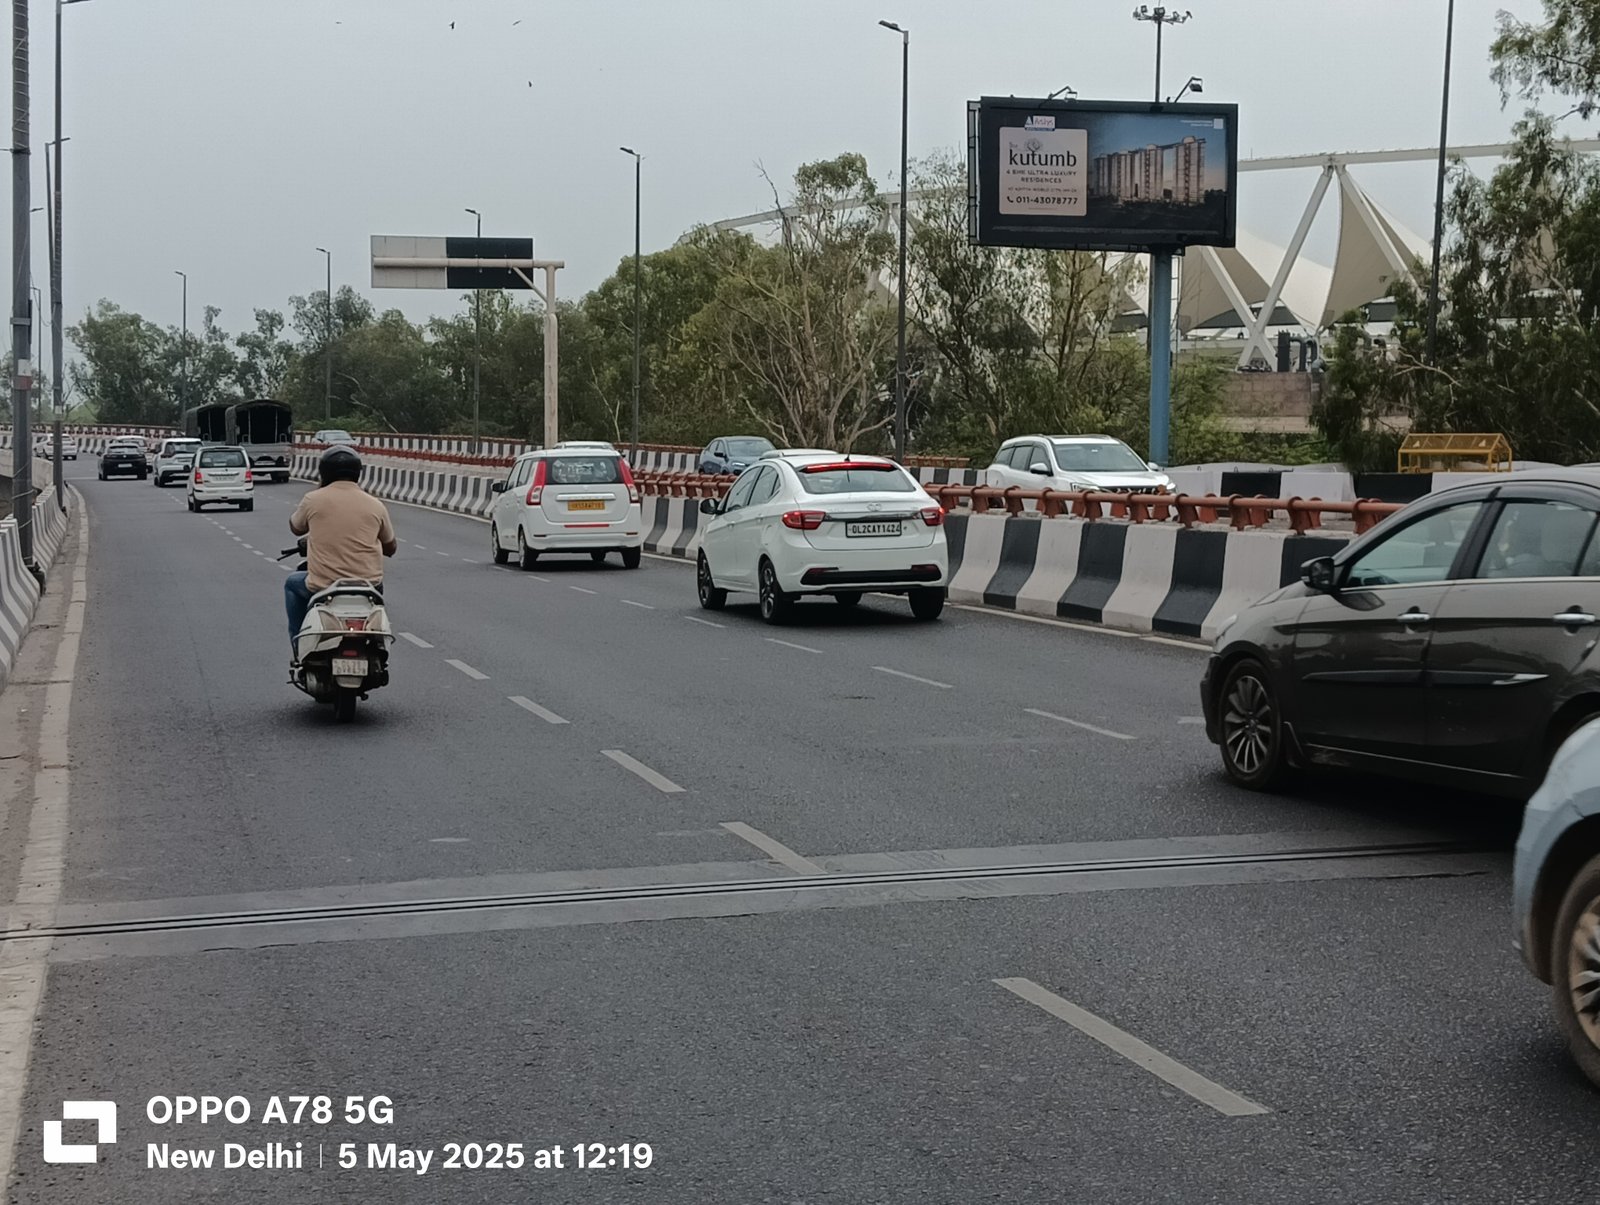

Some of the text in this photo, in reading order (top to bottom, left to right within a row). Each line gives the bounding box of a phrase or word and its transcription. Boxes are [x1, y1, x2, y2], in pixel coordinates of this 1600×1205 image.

[1009, 149, 1077, 167] kutumb
[1020, 176, 1062, 184] RESIDENCES
[1016, 196, 1078, 205] 011-43078777
